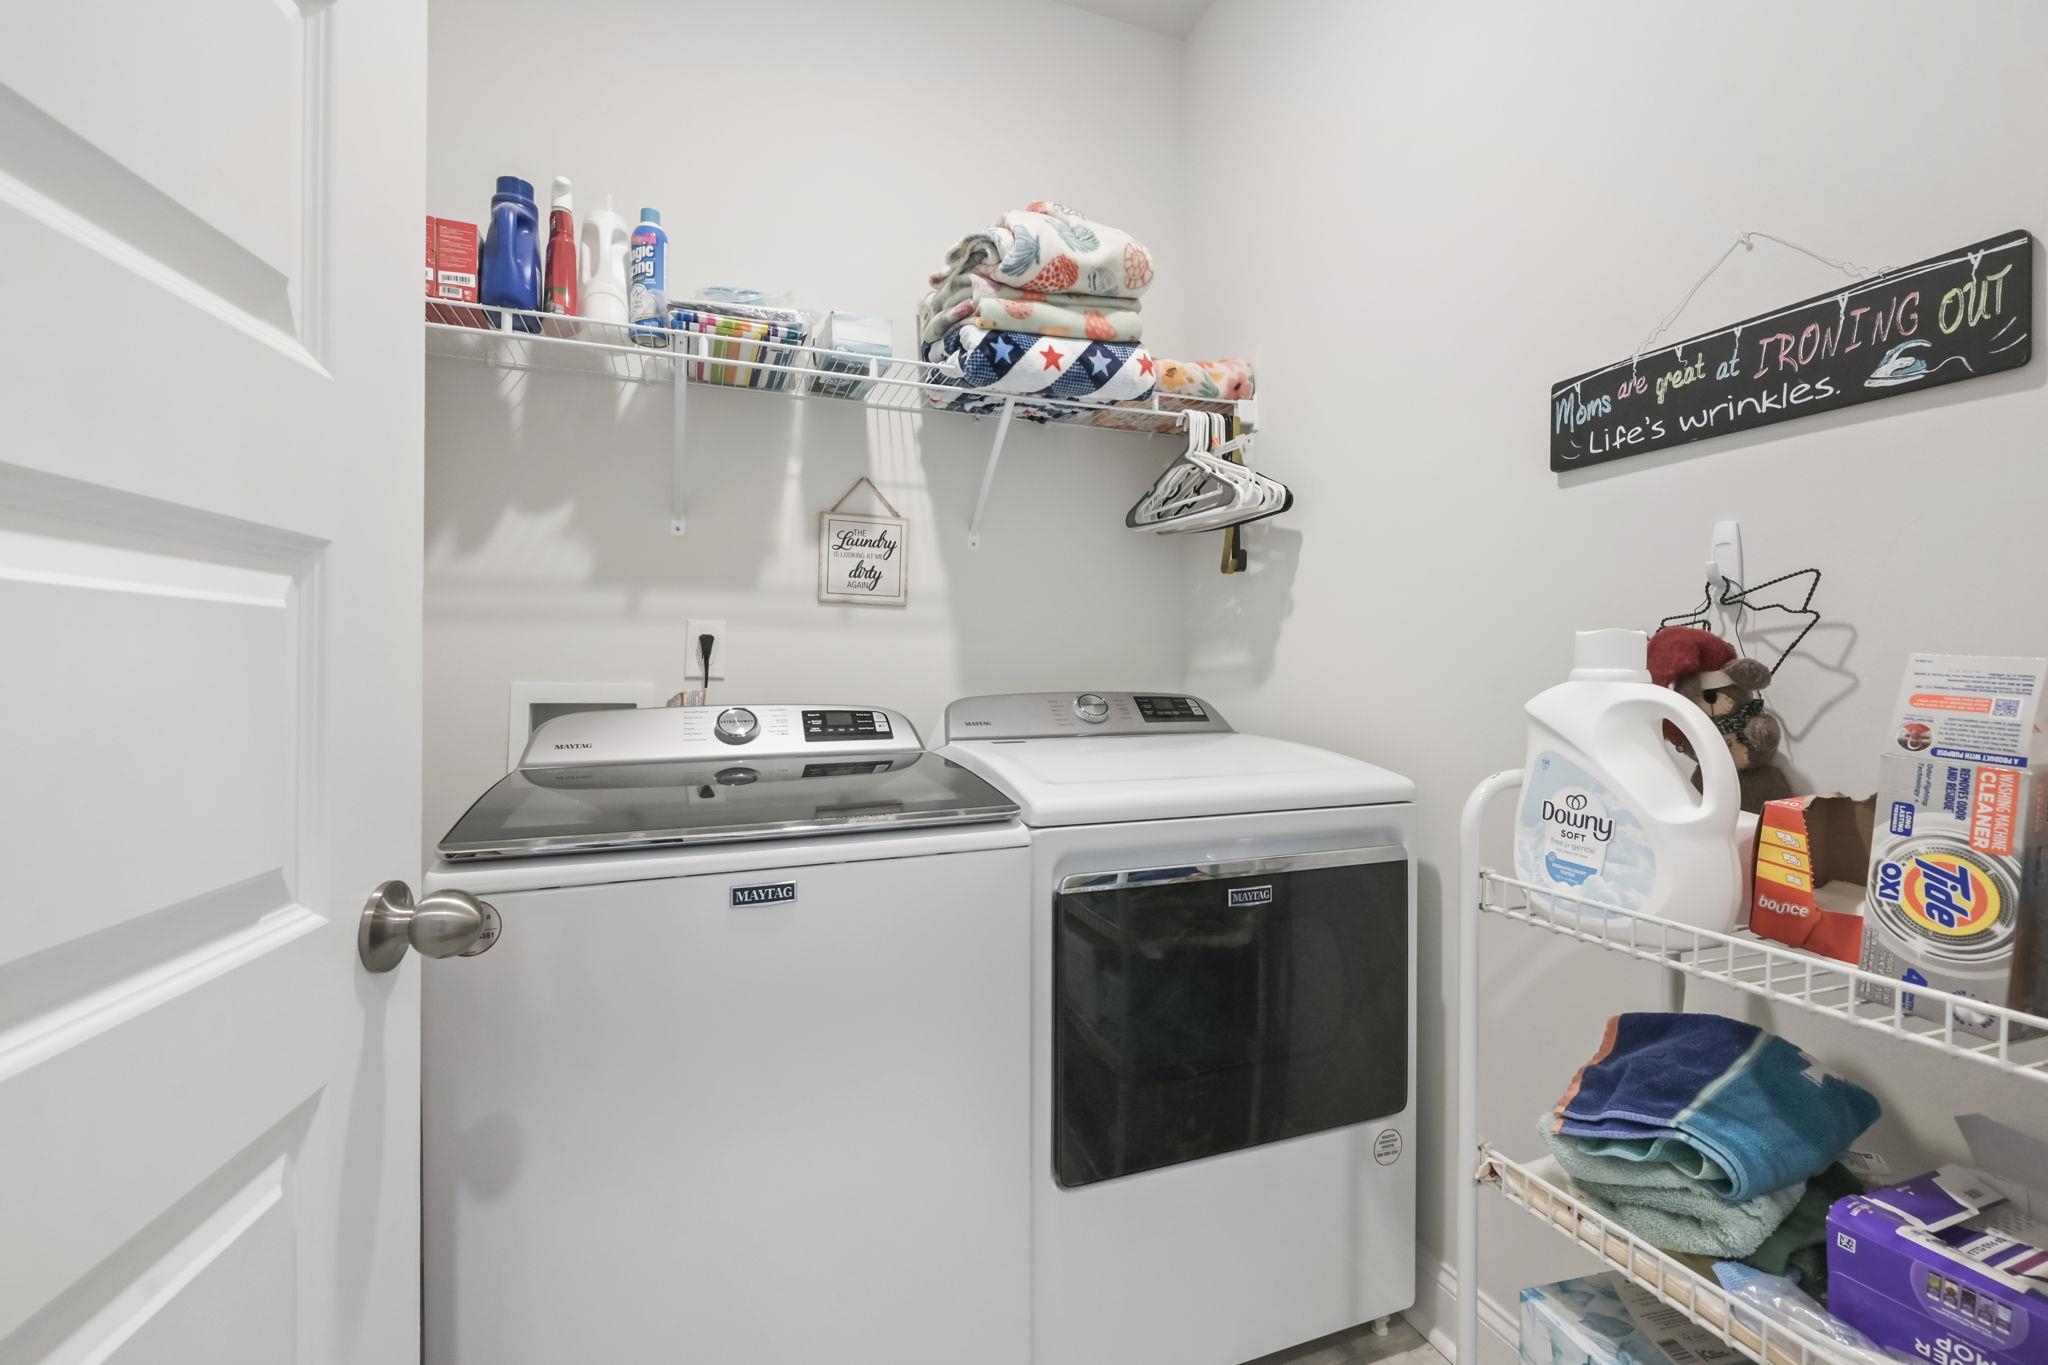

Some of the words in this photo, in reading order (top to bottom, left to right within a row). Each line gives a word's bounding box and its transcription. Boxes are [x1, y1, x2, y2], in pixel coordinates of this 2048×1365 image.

[1555, 390, 1613, 435] Moms
[1617, 374, 1648, 401] are
[1654, 352, 1706, 406] great
[1715, 354, 1740, 381] at
[1752, 290, 1921, 380] IRONING
[1937, 263, 2014, 336] OUT
[1588, 415, 1666, 455] Life's
[1678, 374, 1842, 434] wrinkles.
[853, 529, 867, 537] THE
[832, 529, 898, 561] Laundry
[847, 581, 869, 589] AGAIN
[848, 559, 883, 591] dirty
[964, 720, 992, 728] MAYTAG
[554, 742, 593, 750] MAYTAG
[1936, 749, 1964, 761] PURPOSE
[1964, 752, 1982, 762] WITH
[1983, 754, 2013, 765] PRODUCT
[1914, 762, 1925, 798] Technology
[1921, 763, 1933, 807] Odor-Fighting
[1948, 766, 1959, 783] AND
[1956, 768, 1971, 800] REMOVES
[1998, 771, 2014, 815] WASHING
[1542, 800, 1614, 842] Downy
[1905, 811, 1913, 829] LONG
[1955, 800, 1966, 821] ODOR
[1973, 771, 1997, 849] CLEANER
[1560, 829, 1587, 842] SOFT
[1990, 814, 2010, 852] MACHINE
[1571, 842, 1597, 855] gentle
[1879, 862, 1902, 901] OXI
[1915, 857, 1971, 928] Tide
[735, 886, 793, 903] MAYTAG
[1232, 889, 1270, 903] MAYTAG
[1758, 893, 1810, 917] bounce
